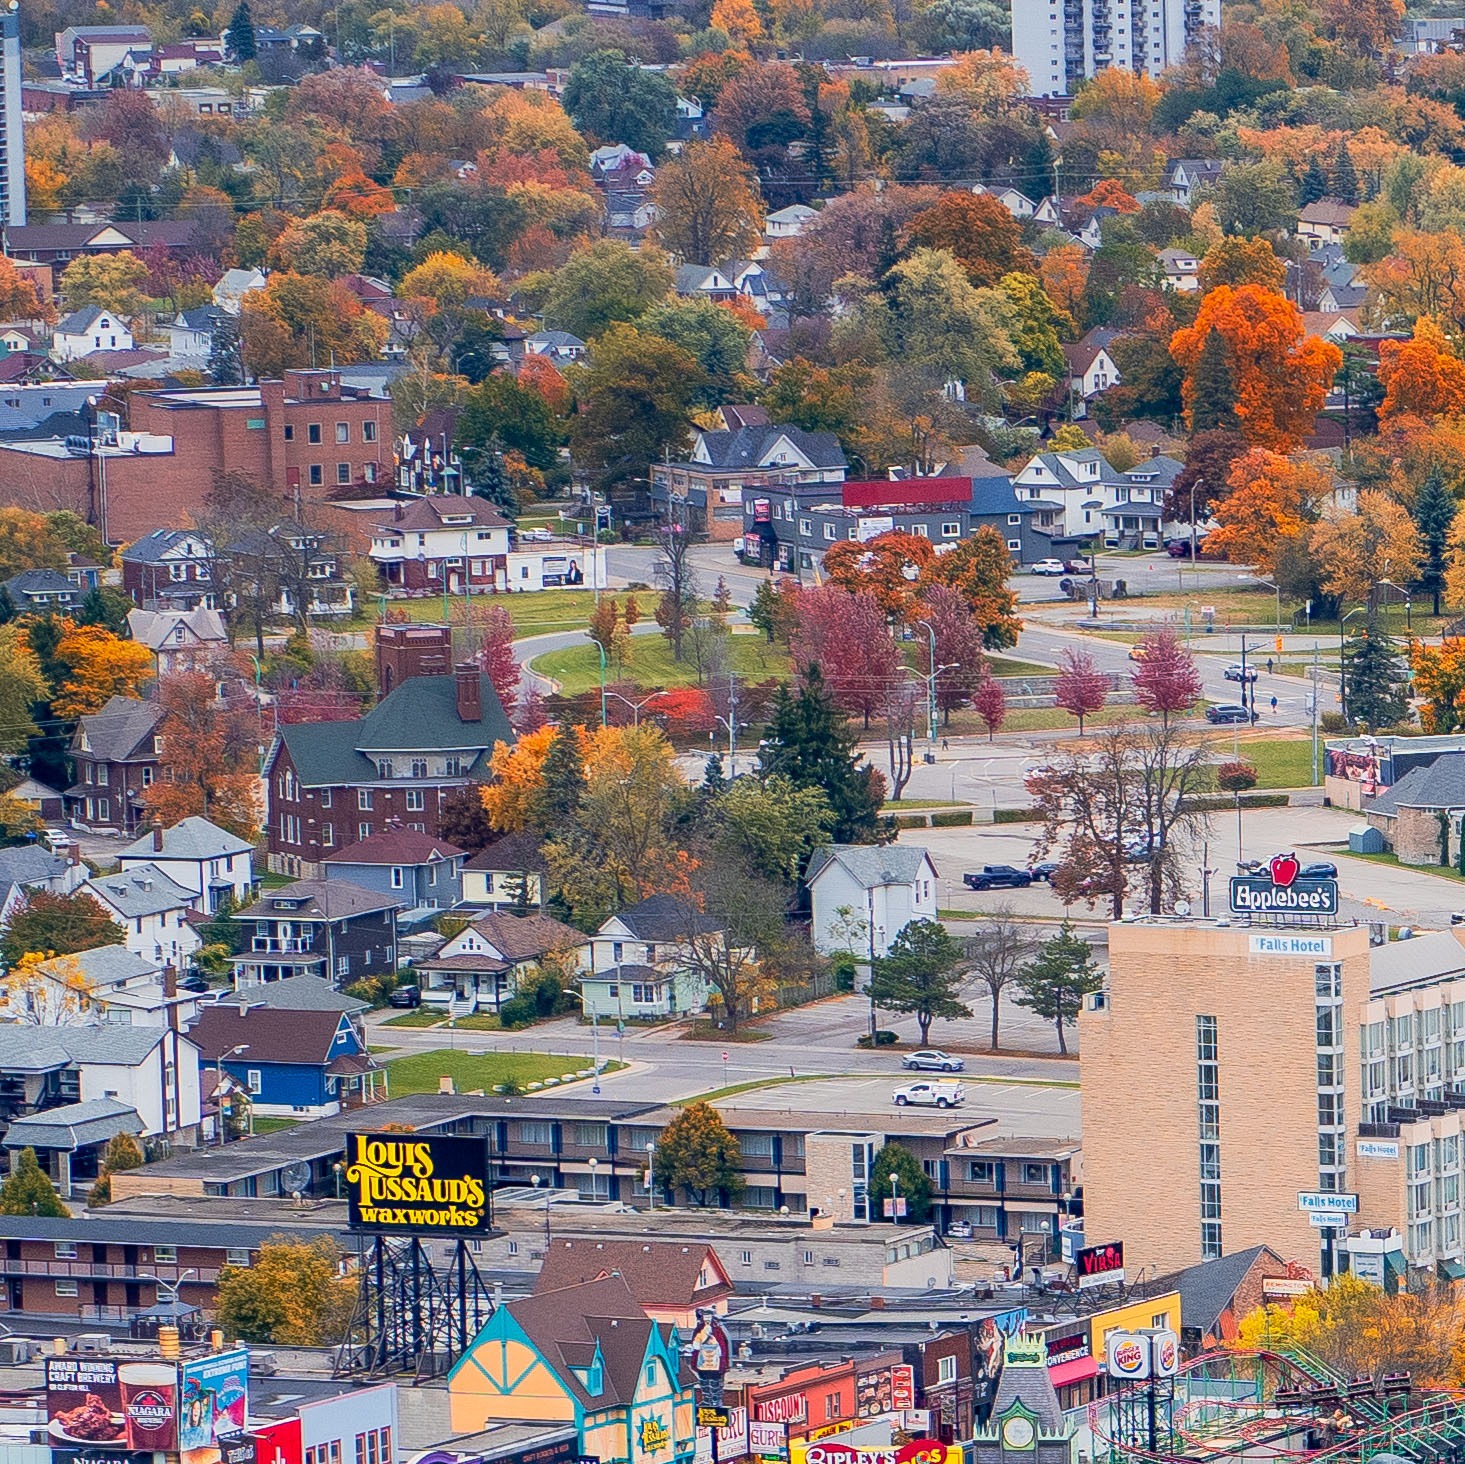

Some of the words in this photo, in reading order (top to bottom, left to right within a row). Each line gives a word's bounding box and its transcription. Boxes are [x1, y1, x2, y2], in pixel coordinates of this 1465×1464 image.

[1236, 885, 1332, 909] Applebee's
[1259, 938, 1287, 951] Falls
[1291, 940, 1325, 953] Hotel
[355, 1134, 434, 1178] LOUIS
[346, 1164, 485, 1208] TUSSAUD'S
[1302, 1195, 1326, 1208] Falls
[1327, 1197, 1356, 1209] Hotel
[358, 1205, 479, 1227] waxworks
[1083, 1250, 1122, 1274] VIRSA
[1117, 1352, 1142, 1365] KING
[127, 1406, 172, 1417] NIAGARA
